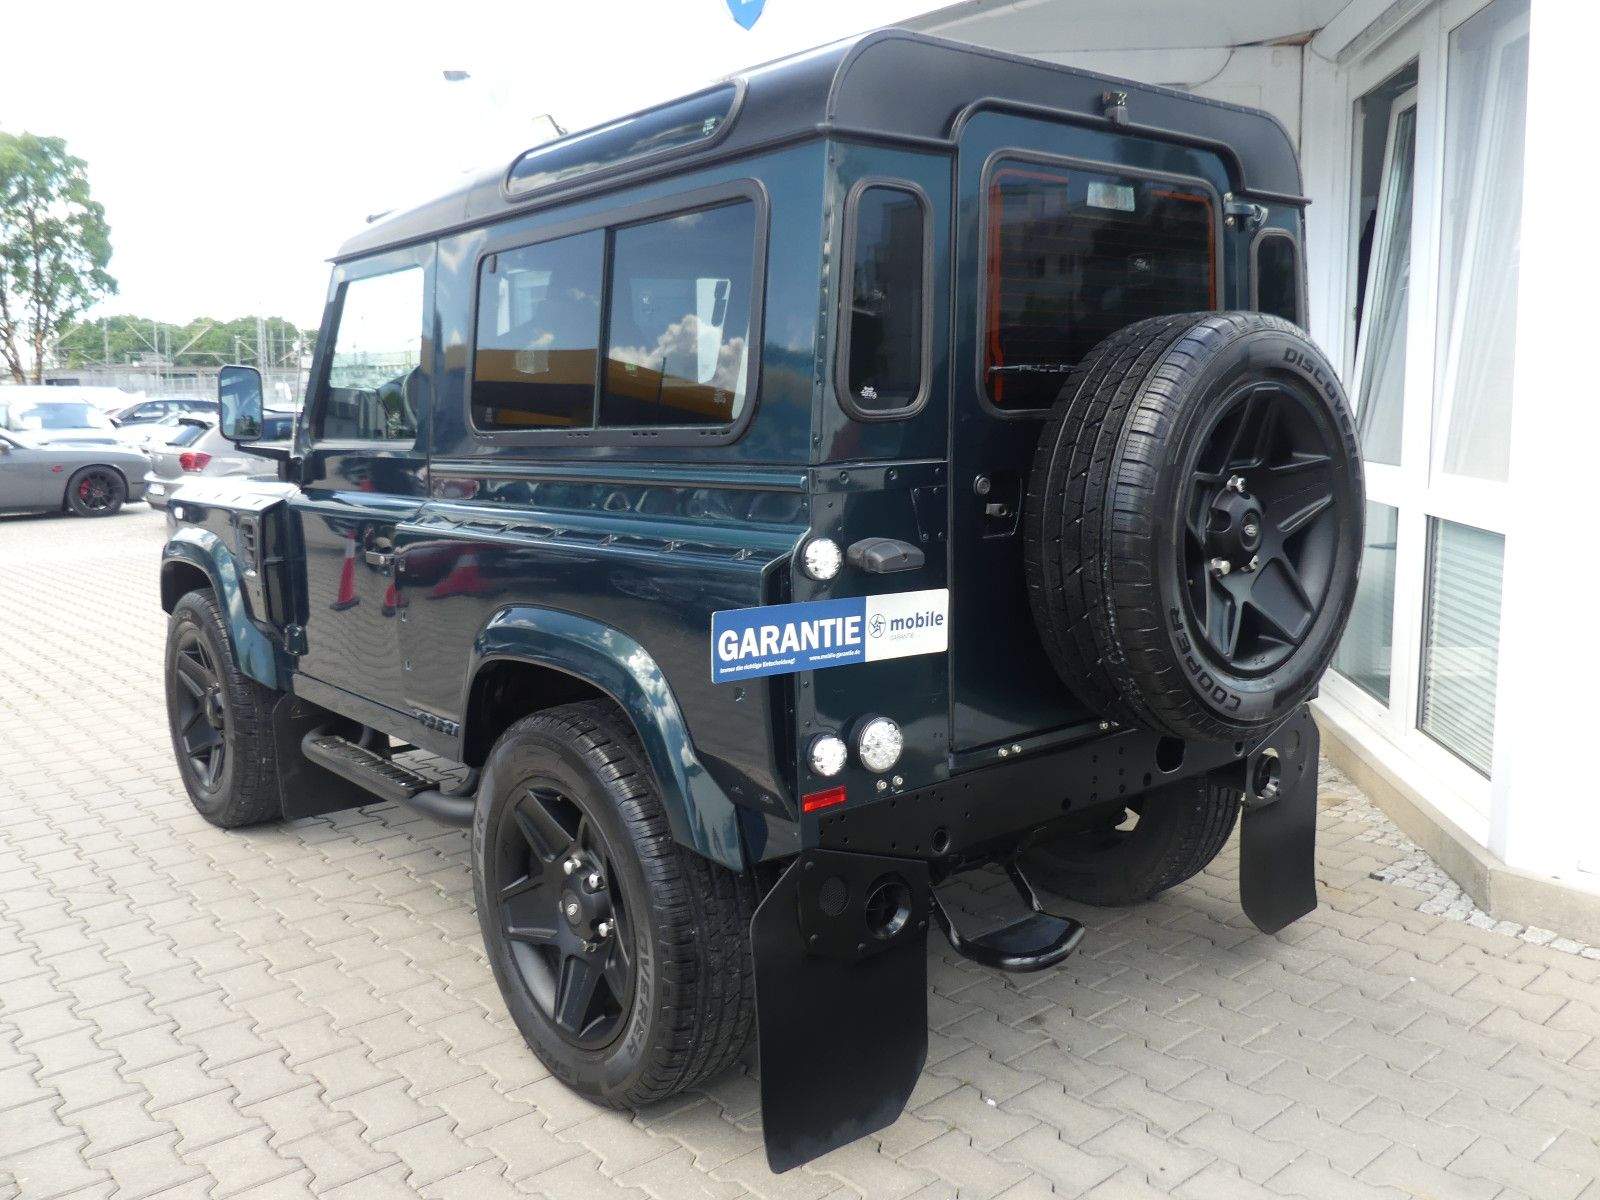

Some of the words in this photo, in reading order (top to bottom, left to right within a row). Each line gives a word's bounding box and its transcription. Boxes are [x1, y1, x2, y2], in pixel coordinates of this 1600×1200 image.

[718, 616, 861, 662] GARANTIE
[890, 611, 944, 632] mobile
[1170, 606, 1242, 711] COOPER
